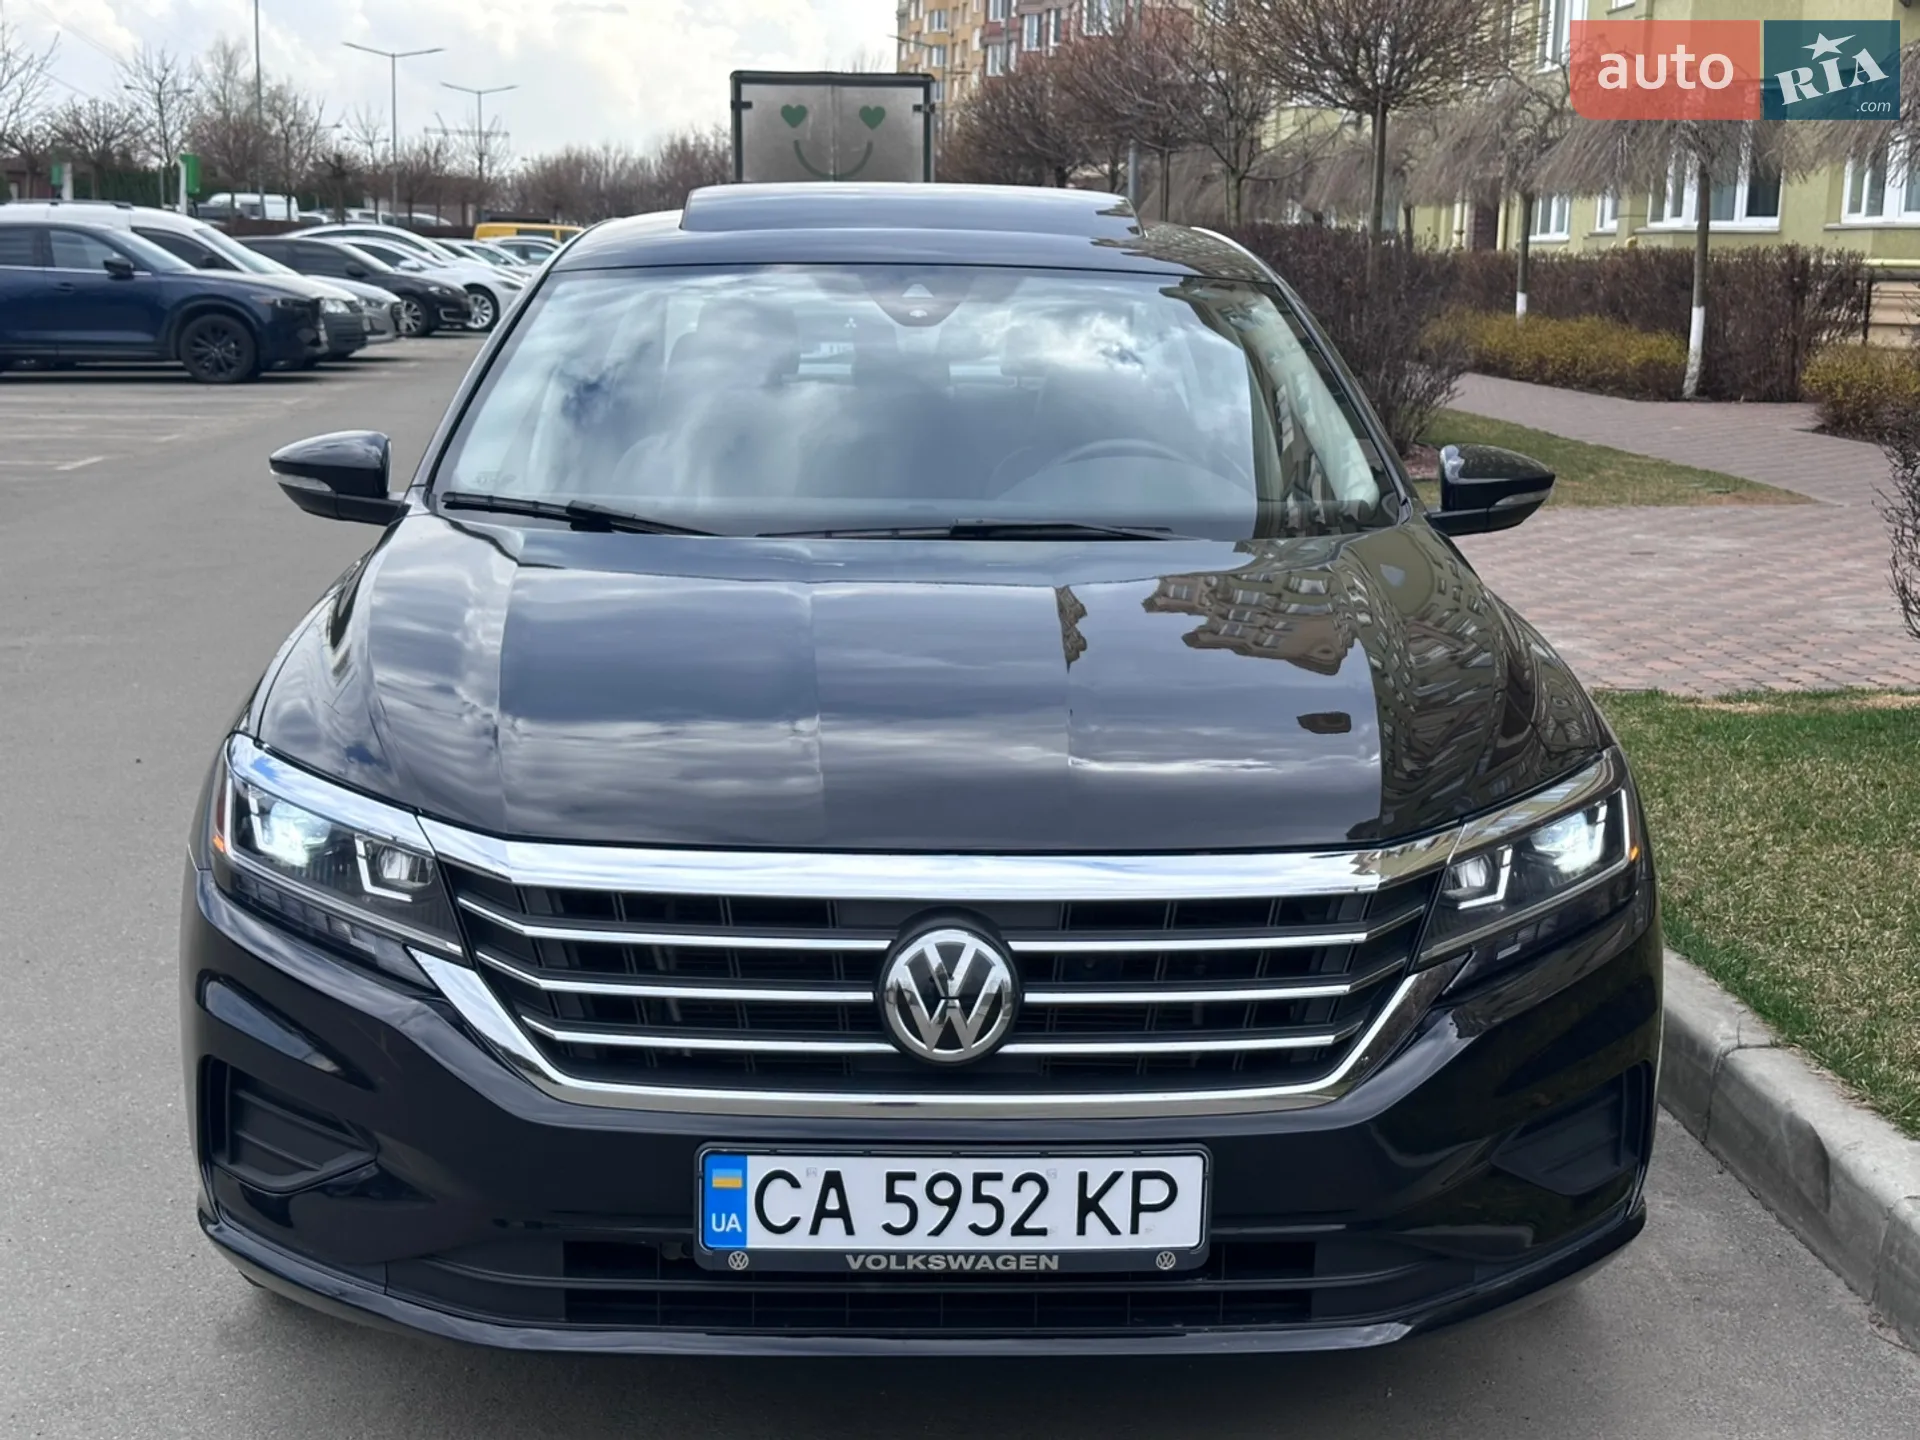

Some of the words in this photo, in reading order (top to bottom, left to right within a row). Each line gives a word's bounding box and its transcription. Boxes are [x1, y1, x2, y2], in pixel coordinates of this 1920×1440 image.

[754, 1169, 855, 1236] CA
[881, 1170, 1050, 1237] 5952
[1075, 1170, 1178, 1236] KP
[711, 1213, 743, 1233] UA
[845, 1254, 1060, 1272] VOLKSWAGEN
